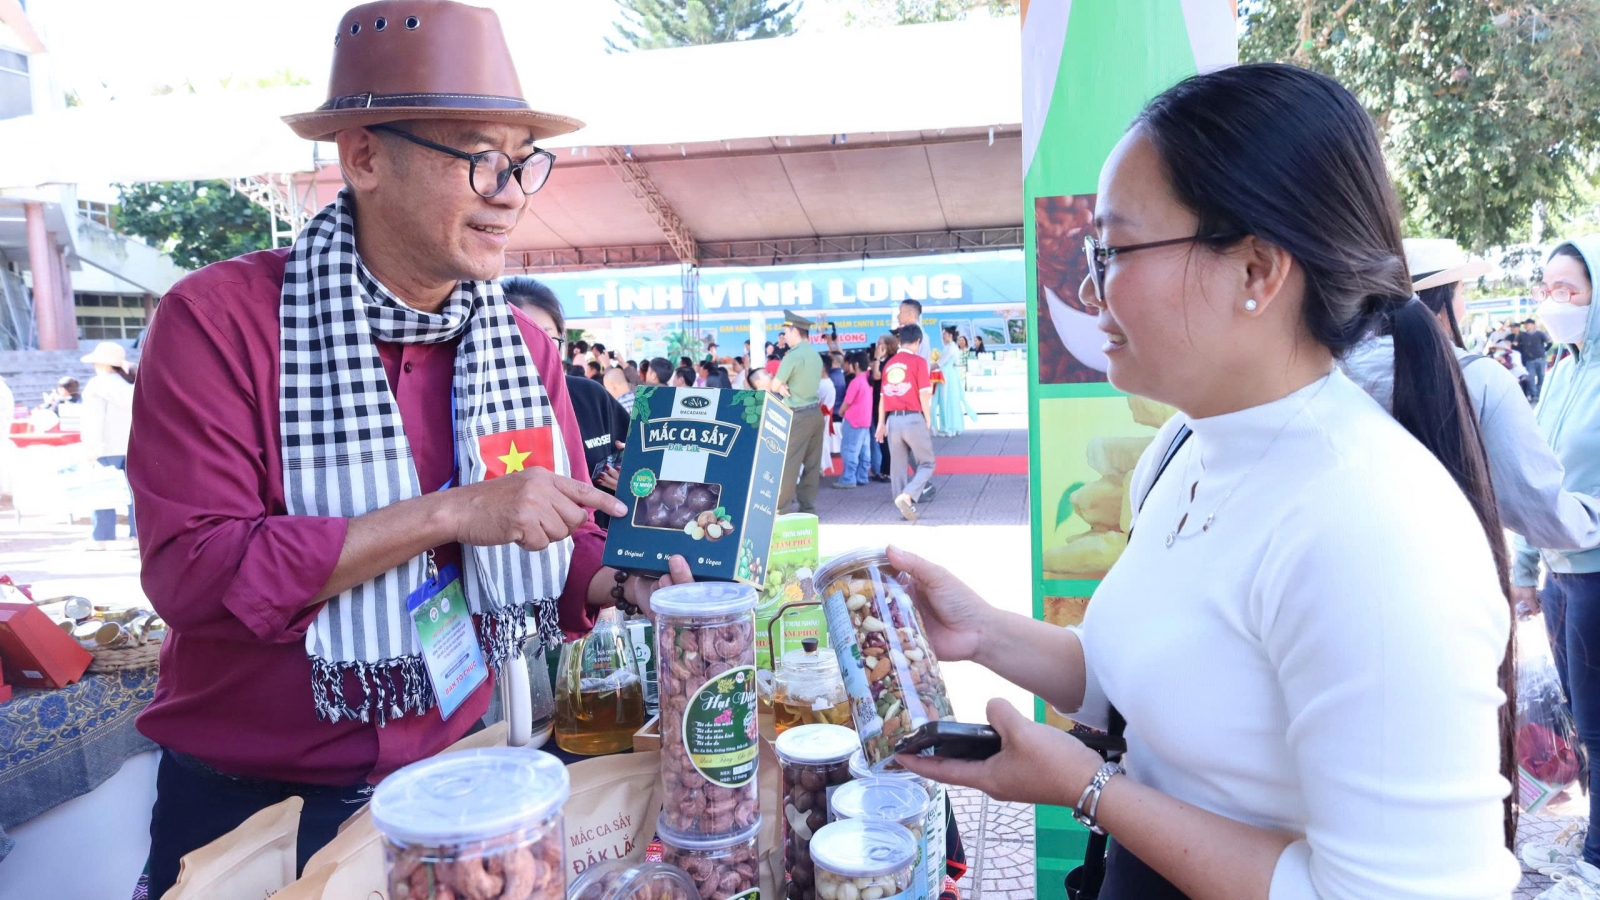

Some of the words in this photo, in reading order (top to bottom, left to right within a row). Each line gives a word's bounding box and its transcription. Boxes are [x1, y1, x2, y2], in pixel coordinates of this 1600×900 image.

[577, 279, 683, 312] TỈNH
[698, 277, 813, 308] VĨNH
[829, 274, 963, 304] LONG
[840, 333, 866, 342] LONG
[648, 422, 677, 442] MẮC
[680, 428, 697, 442] CA
[700, 425, 729, 446] SẤY
[624, 549, 645, 558] Original
[705, 558, 722, 567] Vegan
[700, 691, 731, 711] Hạt
[570, 826, 595, 847] MẮC
[596, 824, 612, 836] CA
[612, 812, 632, 831] SẤY
[572, 847, 608, 875] ĐẮK
